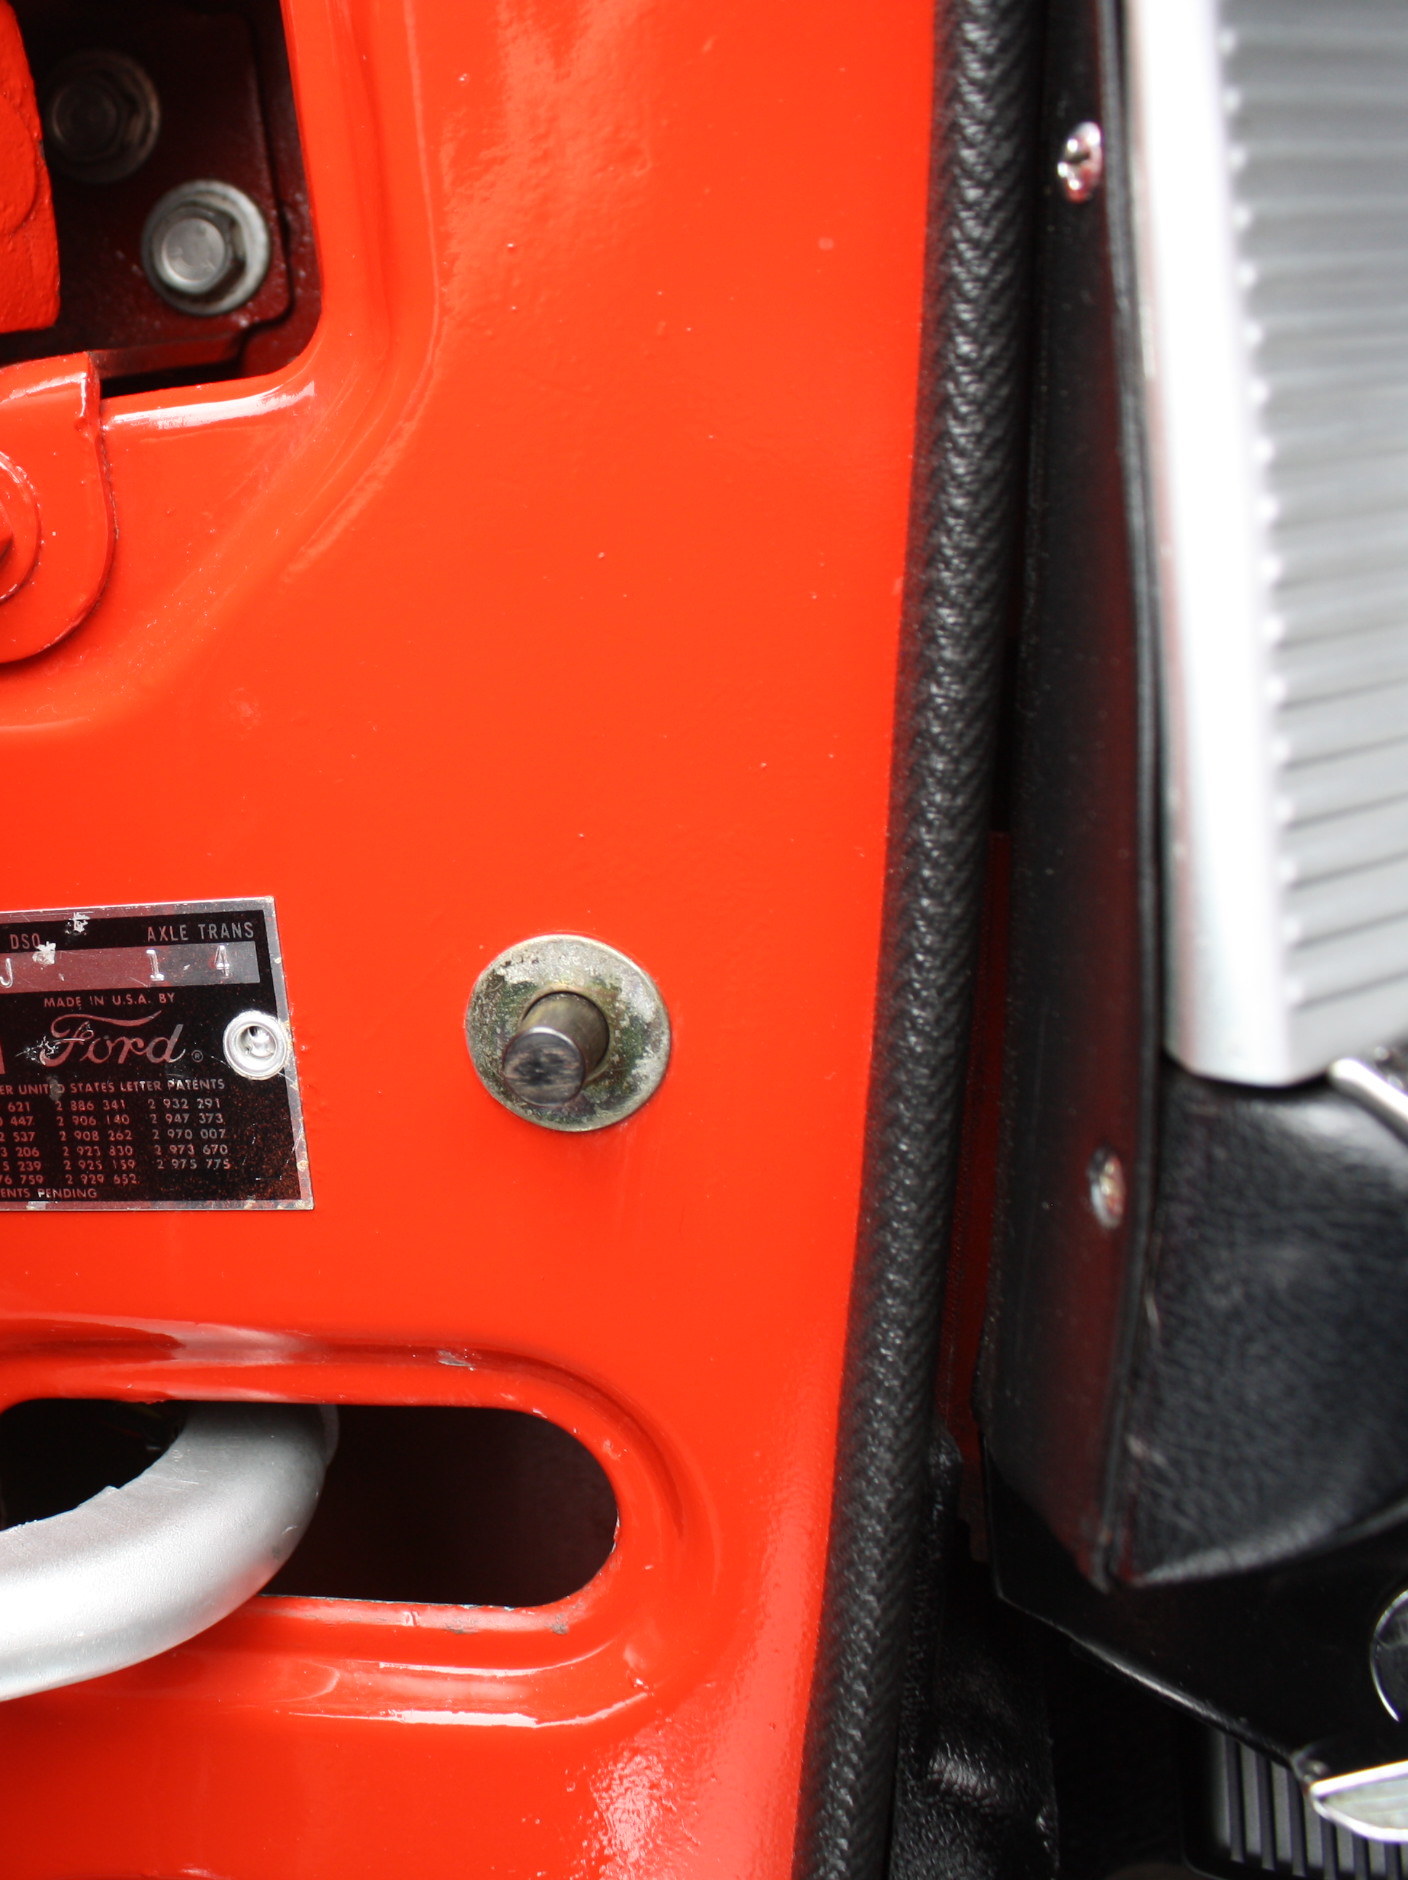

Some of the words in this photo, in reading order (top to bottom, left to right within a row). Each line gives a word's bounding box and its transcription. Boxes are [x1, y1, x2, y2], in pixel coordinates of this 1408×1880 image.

[10, 933, 42, 949] DSO
[147, 924, 189, 942] AXLE
[198, 922, 254, 939] TRANS
[146, 949, 165, 981] 1
[215, 944, 231, 978] 4
[44, 997, 82, 1008] MADE
[89, 996, 105, 1006] IN
[112, 995, 151, 1006] U.S.A.
[159, 993, 176, 1003] BY
[39, 1009, 186, 1068] Ford
[18, 1084, 65, 1095] UNITD
[70, 1082, 115, 1093] STATES
[120, 1081, 162, 1092] LETTER
[168, 1079, 225, 1091] PATENTS
[8, 1102, 30, 1112] 621
[55, 1101, 62, 1111] 2
[71, 1101, 94, 1111] 886
[103, 1100, 125, 1110] 341
[148, 1099, 155, 1109] 2
[163, 1099, 189, 1109] 932
[197, 1098, 220, 1109] 291
[11, 1116, 33, 1126] 447
[57, 1116, 64, 1126] 2
[72, 1116, 96, 1125] 906
[107, 1114, 129, 1124] 140
[150, 1114, 157, 1123] 2
[165, 1114, 189, 1124] 947
[199, 1113, 224, 1124] 373
[13, 1132, 35, 1142] 537
[59, 1131, 66, 1141] 2
[74, 1130, 99, 1141] 908
[108, 1130, 132, 1140] 262
[153, 1130, 159, 1139] 2
[168, 1129, 192, 1139] 970
[200, 1129, 226, 1139] 007
[16, 1147, 39, 1157] 206
[63, 1146, 69, 1156] 2
[77, 1146, 100, 1156] 923
[109, 1146, 133, 1156] 830
[154, 1145, 161, 1155] 2
[170, 1144, 194, 1155] 973
[203, 1145, 228, 1154] 670
[17, 1161, 41, 1171] 239
[64, 1161, 71, 1170] 2
[79, 1160, 102, 1170] 925
[113, 1160, 135, 1170] 159
[157, 1160, 164, 1169] 2
[172, 1159, 197, 1169] 975
[206, 1159, 231, 1169] 775
[20, 1175, 44, 1184] 759
[66, 1175, 72, 1184] 2
[81, 1174, 104, 1184] 929
[114, 1174, 137, 1184] 652
[38, 1188, 97, 1198] PENDING
